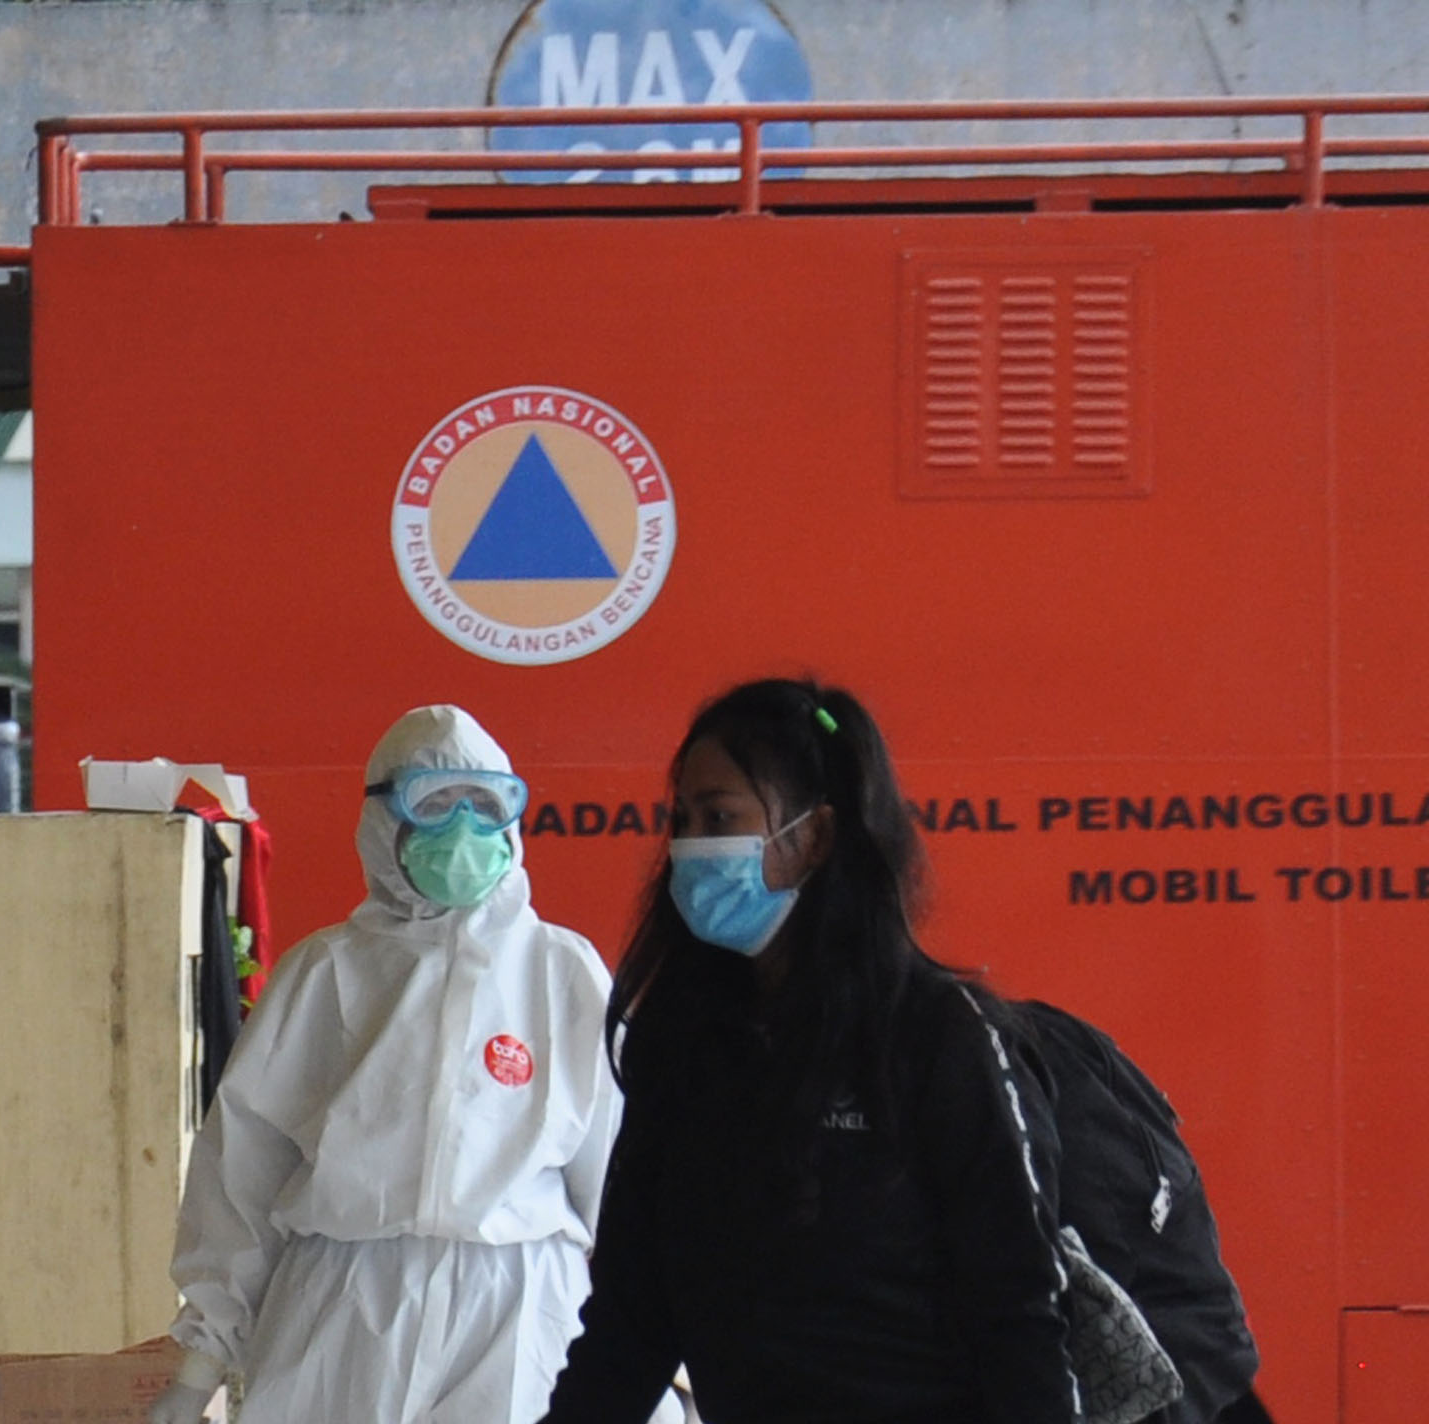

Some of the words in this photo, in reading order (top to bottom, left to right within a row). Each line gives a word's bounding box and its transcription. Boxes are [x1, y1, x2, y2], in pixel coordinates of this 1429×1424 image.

[540, 28, 756, 108] MAX
[407, 405, 496, 495] BADAN
[512, 396, 656, 494] NASIONAL
[406, 522, 598, 652] PENANGGULANGAN
[600, 514, 664, 627] BENCANA
[1067, 868, 1255, 904] MOBIL
